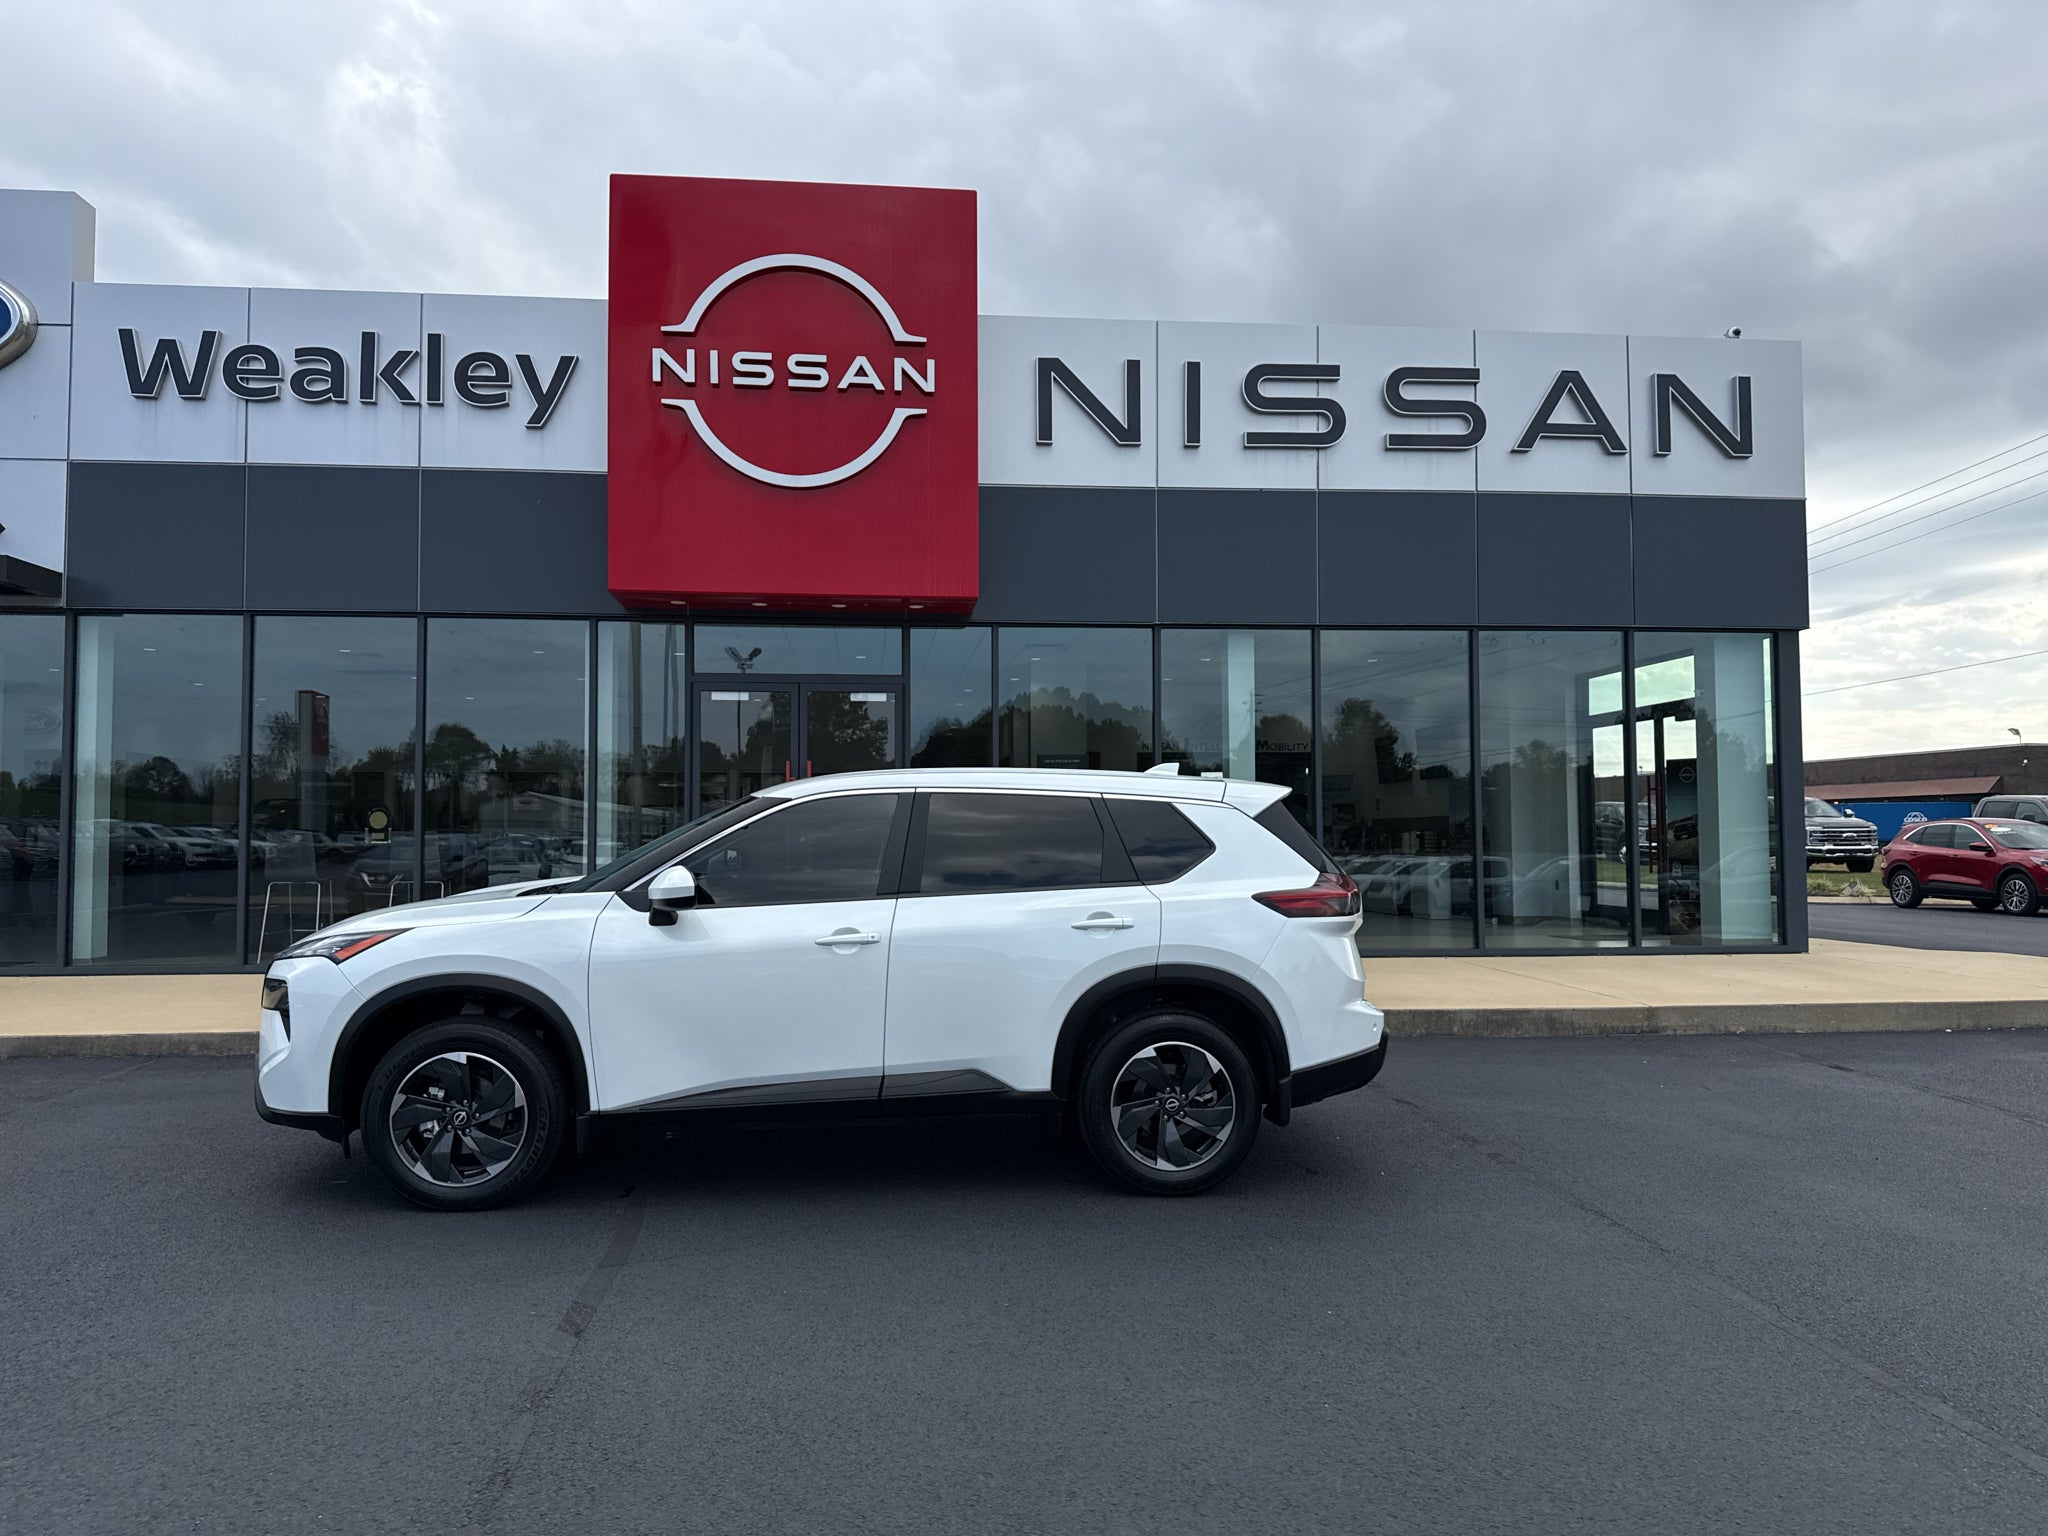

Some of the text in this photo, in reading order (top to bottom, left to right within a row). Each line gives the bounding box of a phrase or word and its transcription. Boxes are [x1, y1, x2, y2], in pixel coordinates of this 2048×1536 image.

[118, 327, 580, 429] Weakley
[651, 347, 936, 393] NISSAN
[1035, 356, 1754, 458] NISSAN
[1256, 740, 1309, 751] MOBILITY
